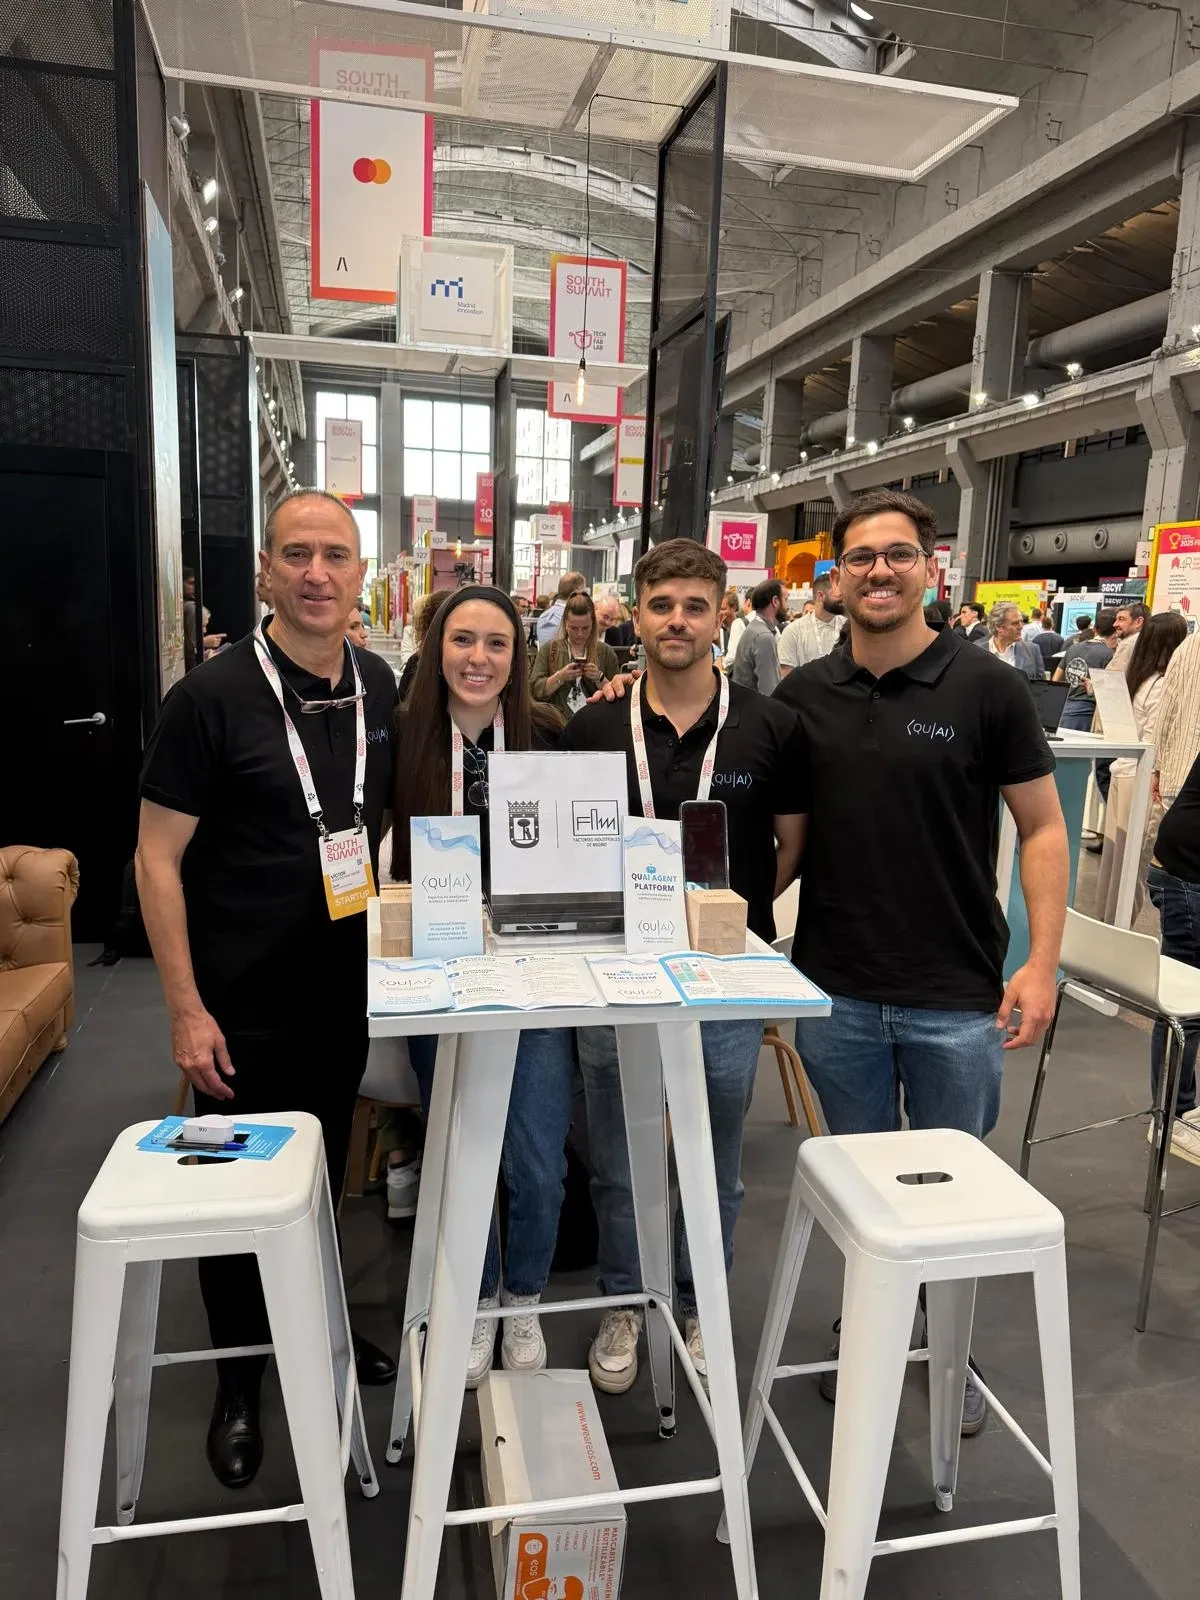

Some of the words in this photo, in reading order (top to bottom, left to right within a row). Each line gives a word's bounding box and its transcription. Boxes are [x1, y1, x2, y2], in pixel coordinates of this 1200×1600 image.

[336, 69, 399, 89] SOUTH
[566, 274, 605, 287] SOUTH
[566, 285, 612, 298] SUMMIT
[480, 508, 493, 519] 10
[326, 839, 358, 854] SOUTH
[327, 845, 364, 862] SUMMIT
[652, 874, 677, 883] AGENT
[634, 882, 675, 892] PLATFORM
[335, 889, 370, 907] STARTUP
[608, 1527, 618, 1573] MASCARILLA
[529, 1559, 540, 1576] eos
